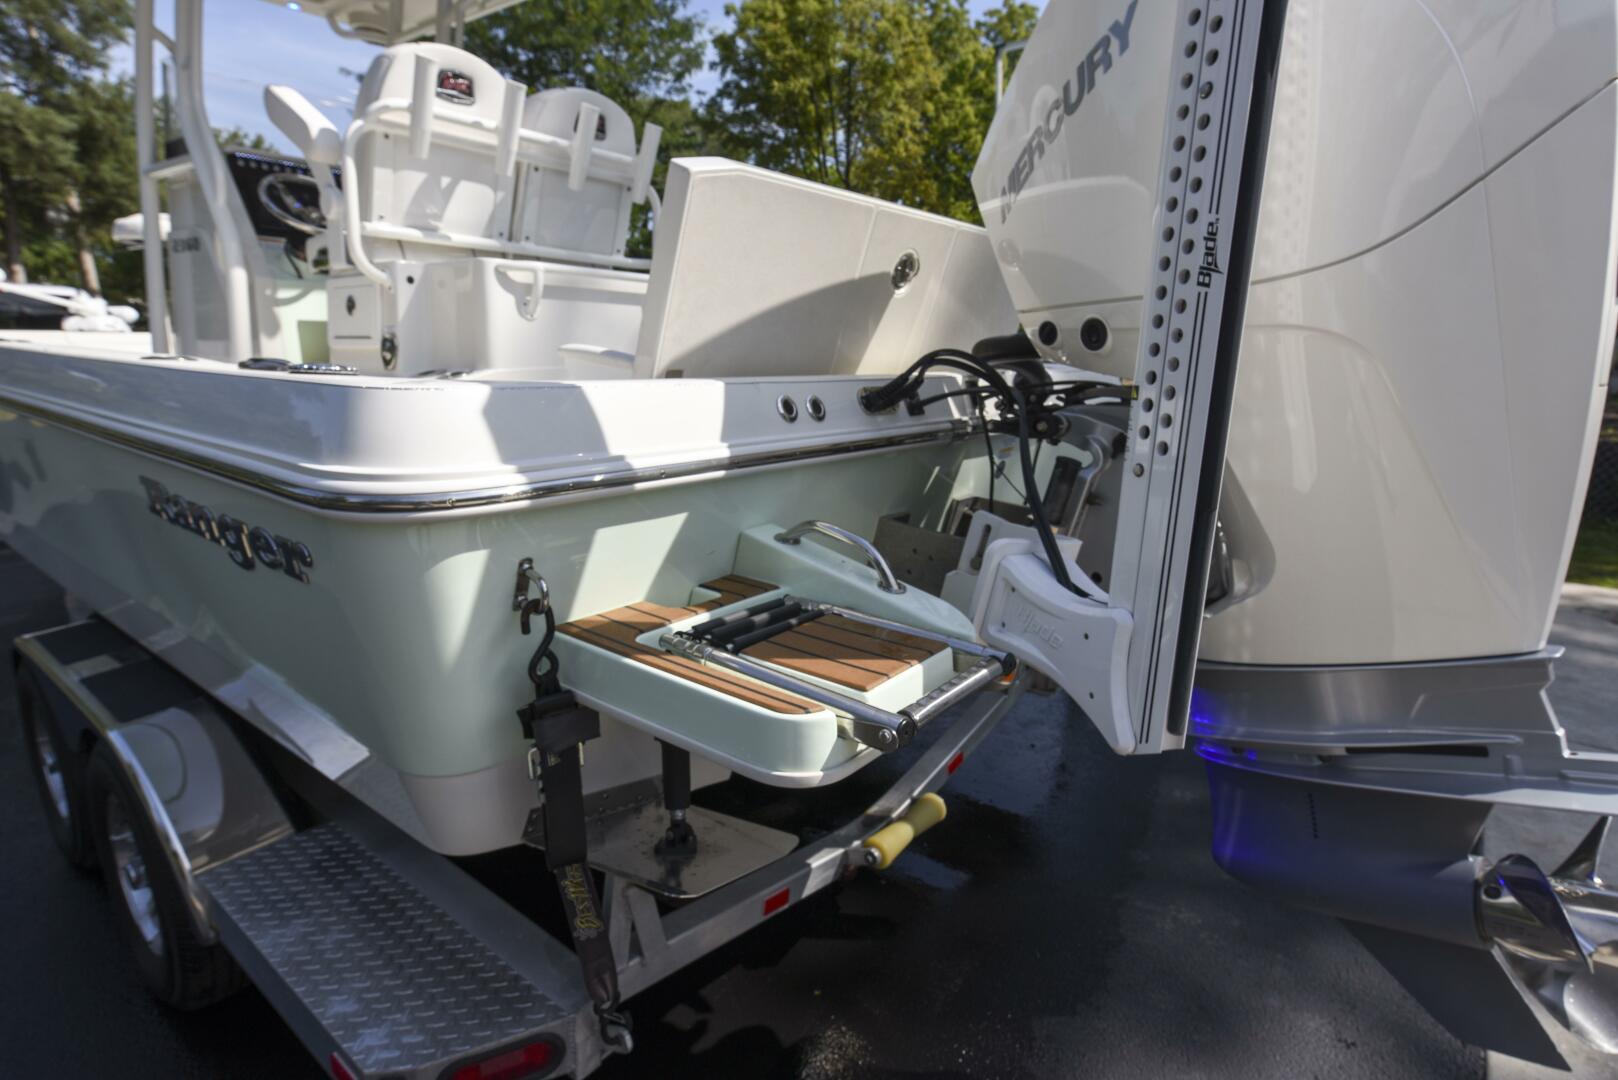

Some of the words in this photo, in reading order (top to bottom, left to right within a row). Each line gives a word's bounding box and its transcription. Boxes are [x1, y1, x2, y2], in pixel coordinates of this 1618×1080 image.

[1000, 0, 1139, 225] MERCURY
[1196, 221, 1224, 289] Blade
[138, 475, 314, 584] Ranger
